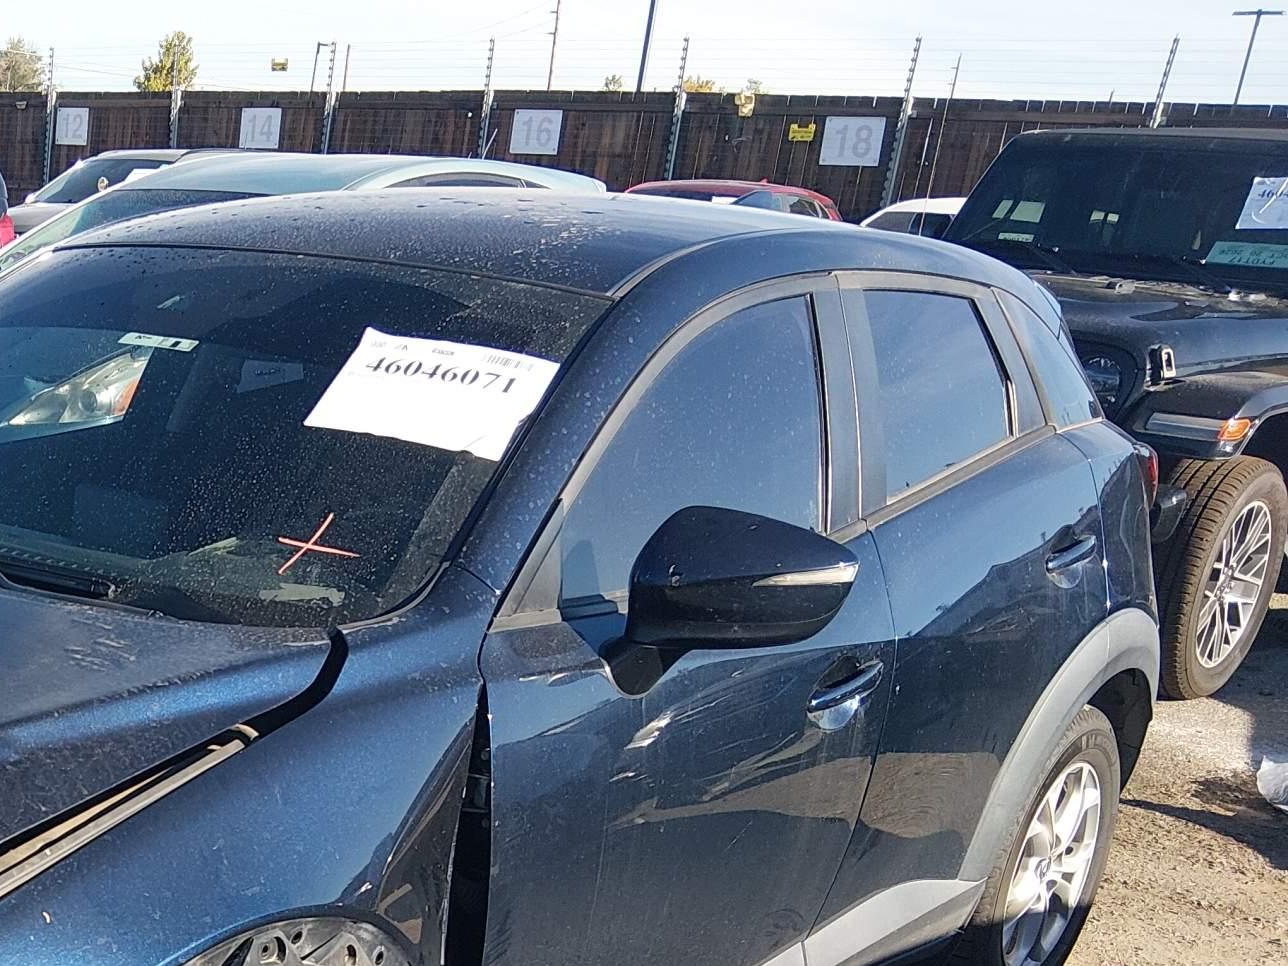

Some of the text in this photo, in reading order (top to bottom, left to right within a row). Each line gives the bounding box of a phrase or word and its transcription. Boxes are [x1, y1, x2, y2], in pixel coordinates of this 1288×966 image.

[62, 112, 83, 139] 12
[247, 114, 274, 143] 14
[522, 115, 554, 148] 16
[835, 124, 873, 158] 18
[365, 356, 517, 393] 46046071
